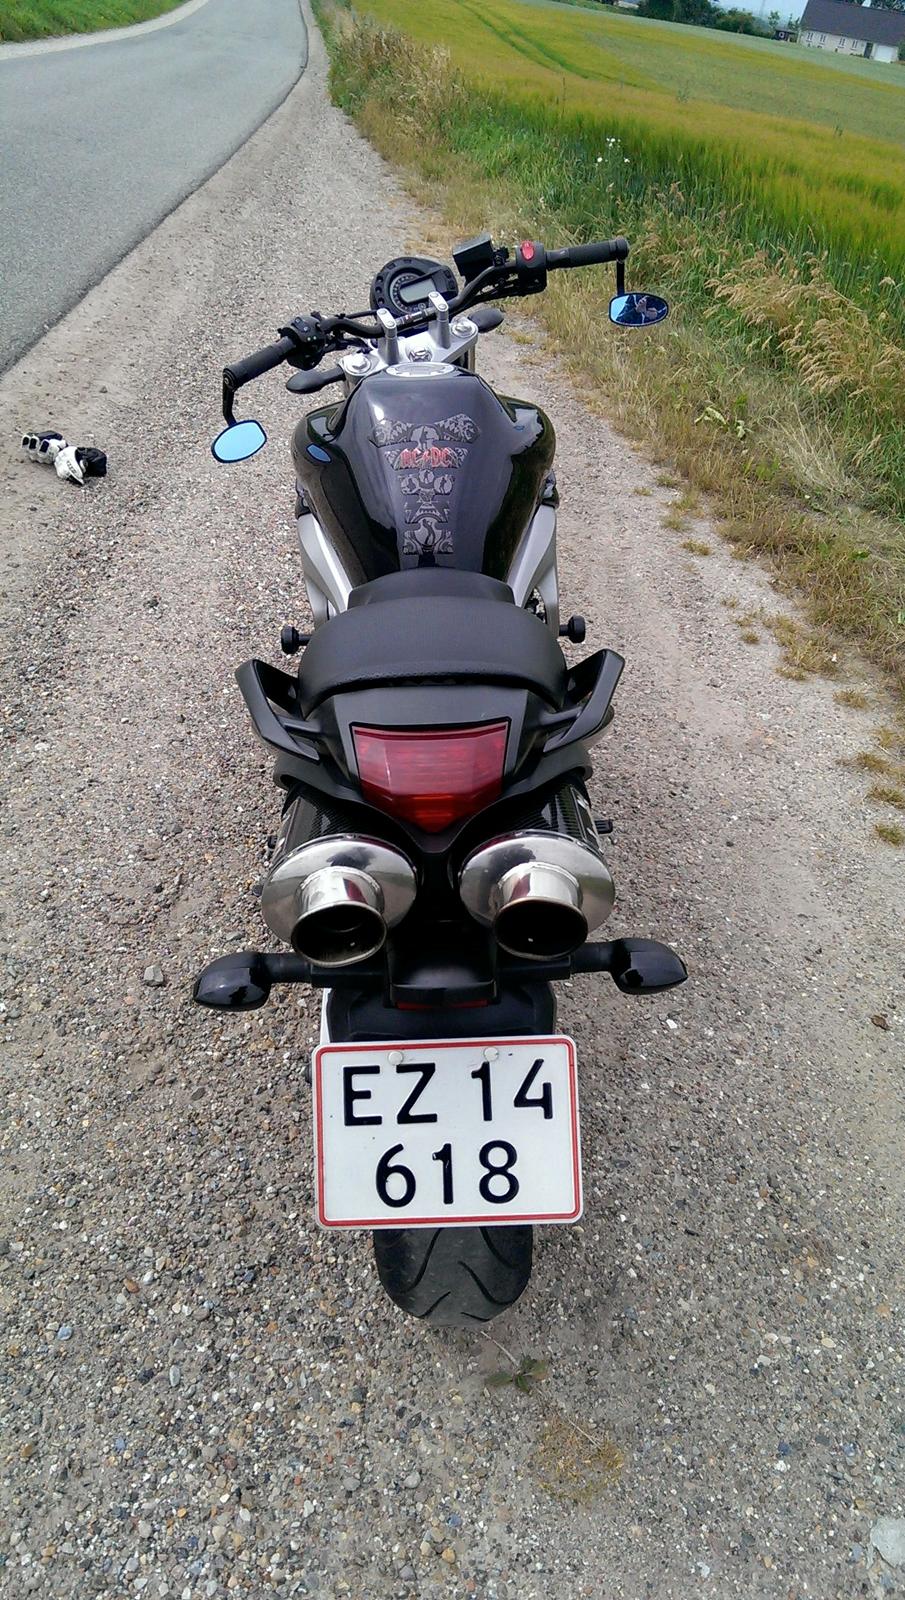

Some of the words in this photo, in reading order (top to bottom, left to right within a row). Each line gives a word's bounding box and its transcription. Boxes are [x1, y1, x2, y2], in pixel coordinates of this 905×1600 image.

[343, 1062, 438, 1127] EZ
[471, 1058, 553, 1122] 14
[375, 1139, 520, 1209] 618
